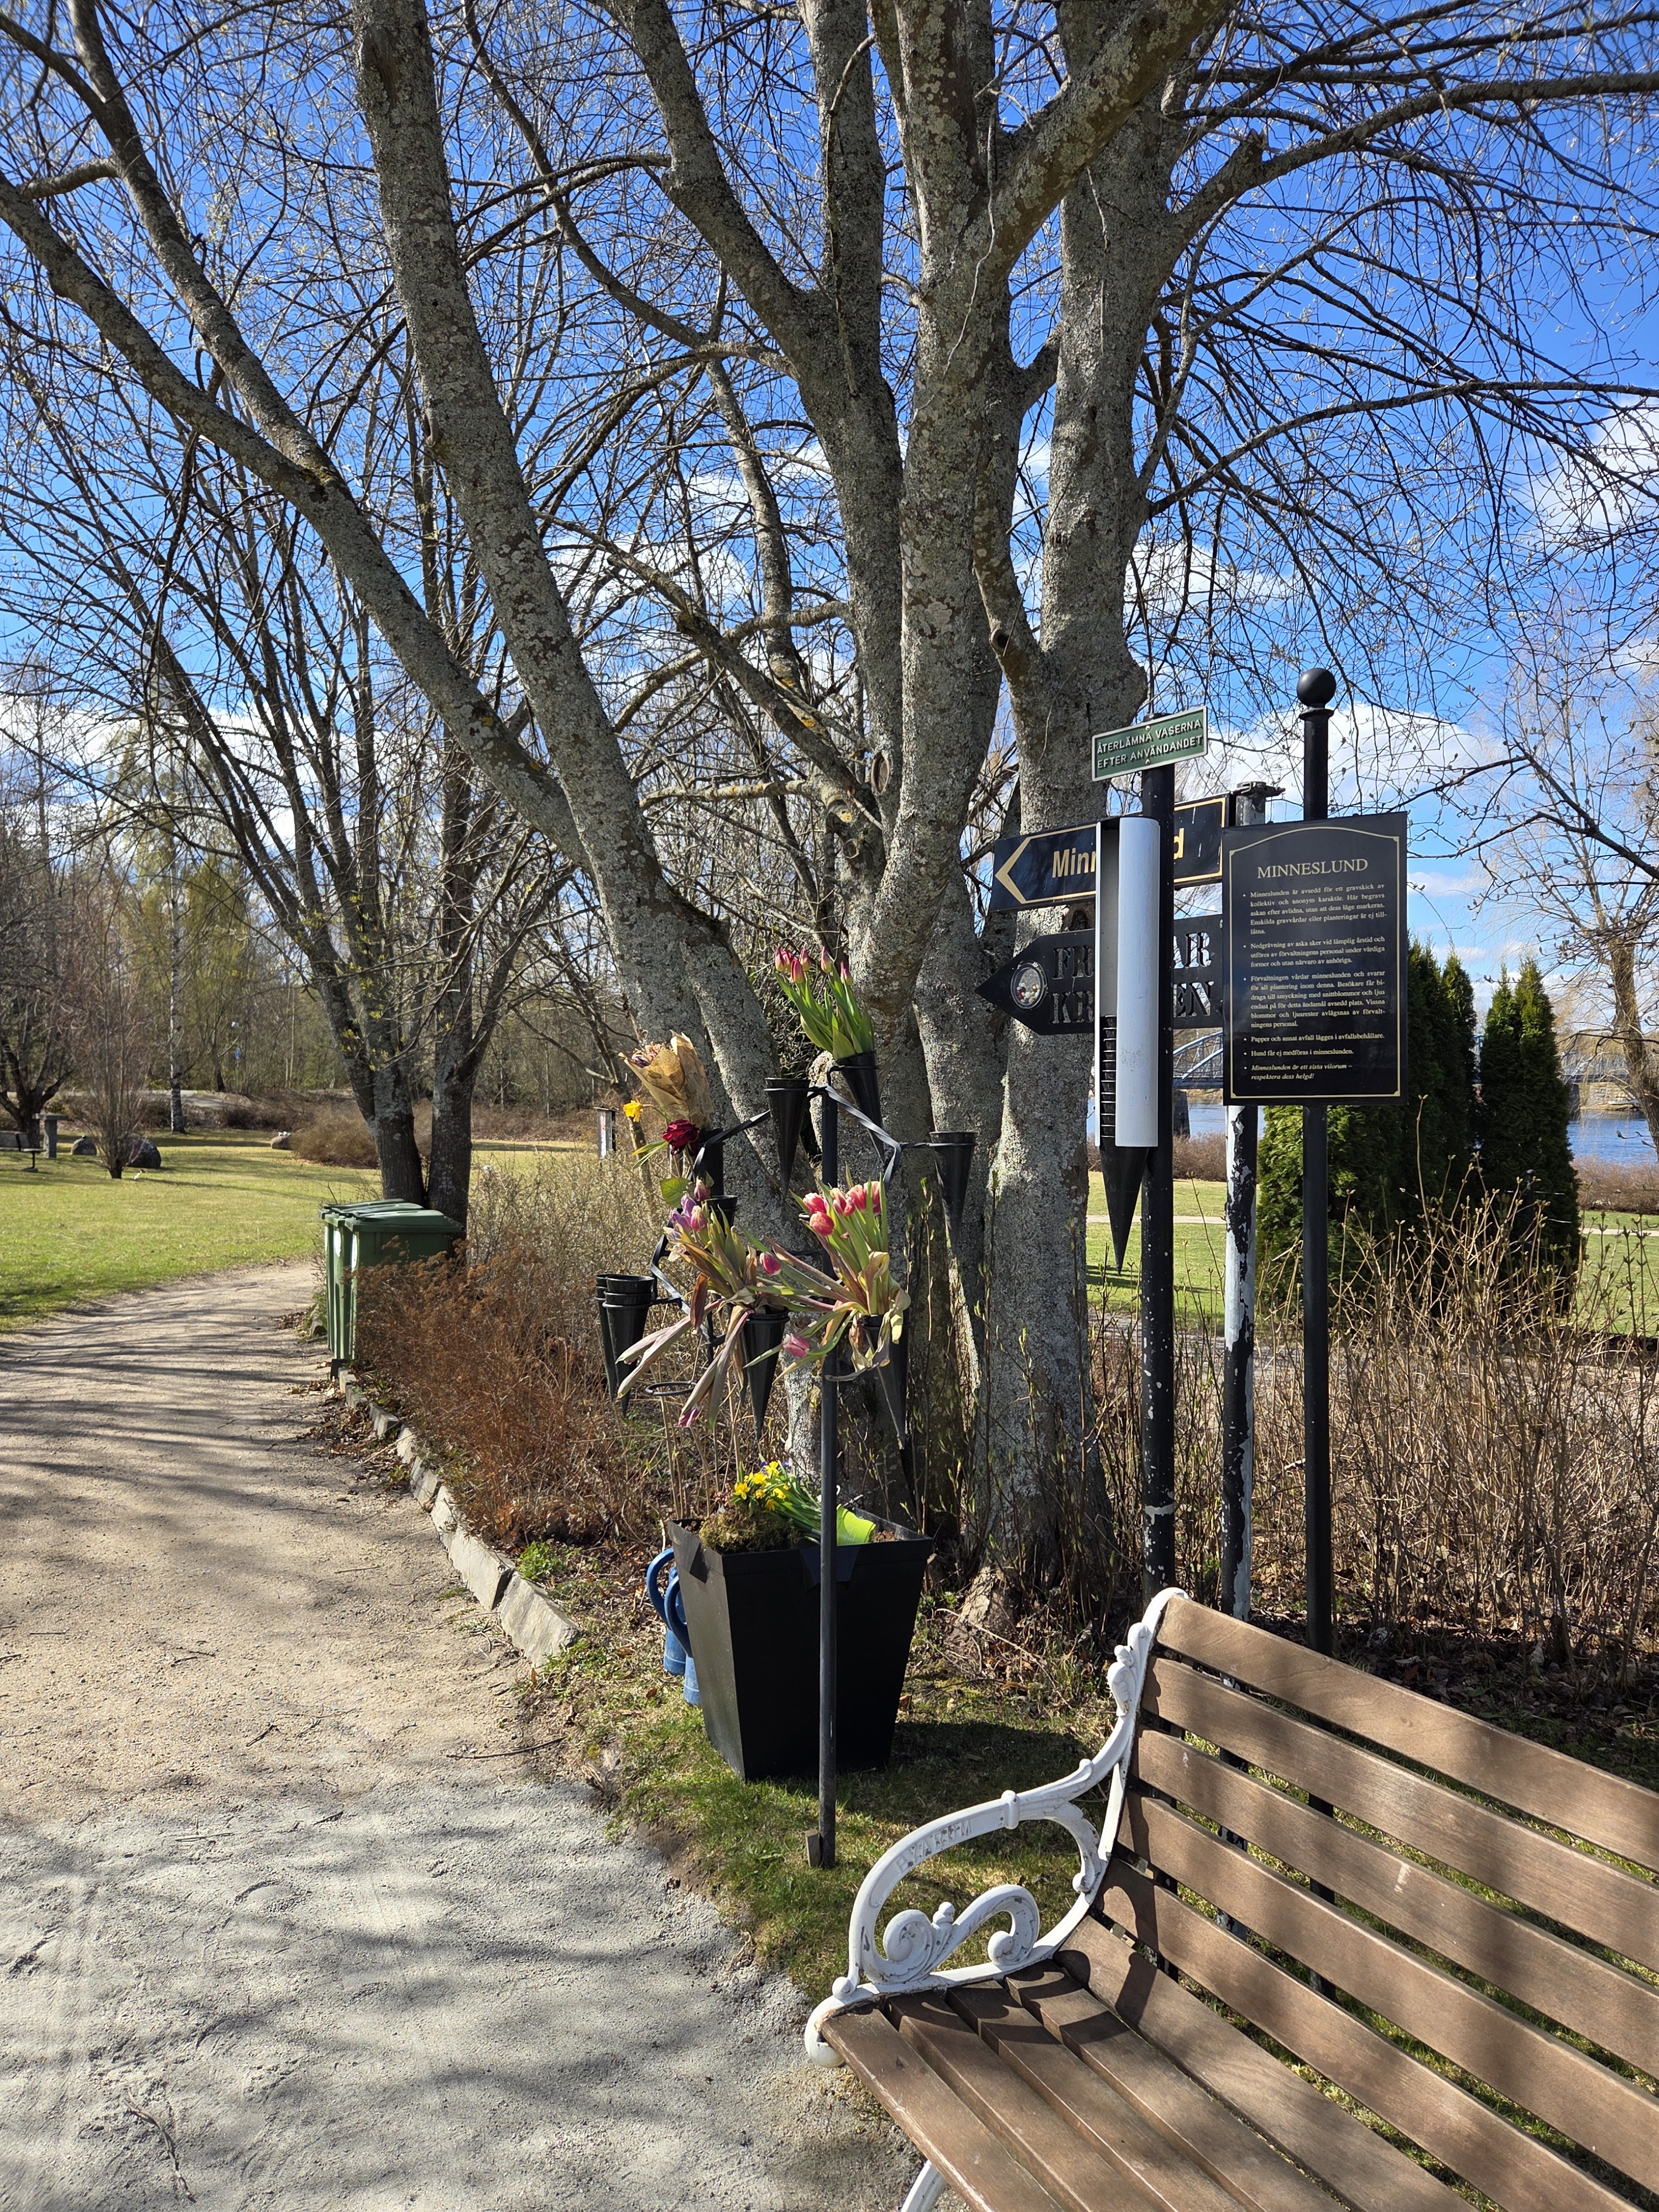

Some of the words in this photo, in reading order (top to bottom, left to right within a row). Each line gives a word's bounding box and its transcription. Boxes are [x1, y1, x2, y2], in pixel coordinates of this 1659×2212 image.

[1097, 733, 1152, 754] ÅTERLÄMNA
[1156, 719, 1201, 739] VASERNA
[1097, 754, 1126, 769] EFTER
[1130, 735, 1202, 761] ANVÄNDANDET
[1257, 858, 1368, 879] MINNESLUND
[1250, 889, 1289, 898] Minneslunden
[1345, 883, 1374, 892] gravskick
[1361, 893, 1385, 901] begravs
[1281, 907, 1304, 915] avlidna,
[1276, 916, 1307, 925] gravvårdar
[1323, 913, 1359, 922] planteringar
[1251, 941, 1286, 950] Nedgrävning
[1333, 937, 1355, 946] lämplig
[1279, 948, 1318, 958] förvaltningens
[1319, 947, 1344, 956] personal
[1363, 945, 1385, 953] värdiga
[1251, 974, 1288, 982] Förvaltningen
[1270, 983, 1298, 991] plantering
[1276, 992, 1307, 1000] smyckning
